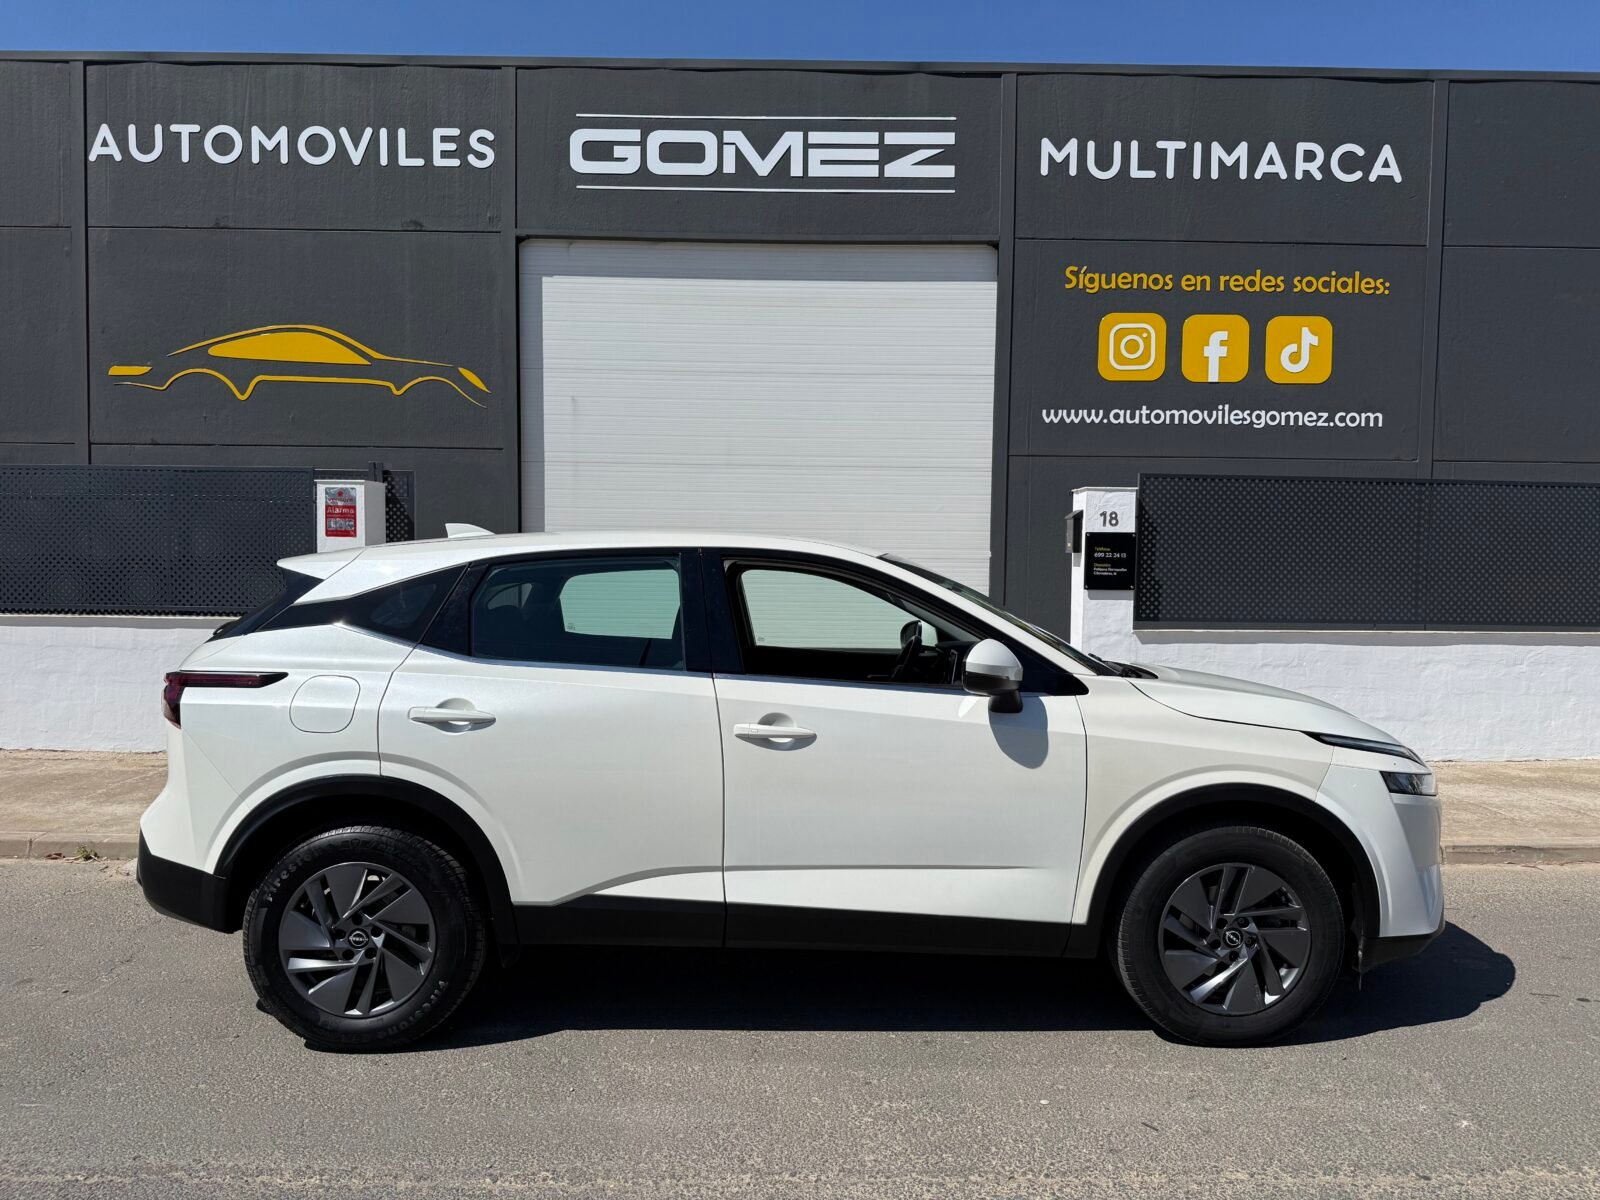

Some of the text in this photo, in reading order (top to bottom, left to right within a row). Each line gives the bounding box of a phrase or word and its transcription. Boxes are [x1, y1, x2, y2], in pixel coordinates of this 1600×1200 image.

[88, 123, 495, 169] AUTOMOVILES
[569, 128, 956, 178] GOMEZ
[1040, 137, 1403, 184] MULTIMARCA
[1065, 265, 1391, 295] Síguenos en redes sociales:
[1041, 404, 1383, 429] www.automovilesgomez.com
[327, 506, 355, 514] Alarma
[1100, 511, 1119, 527] 18
